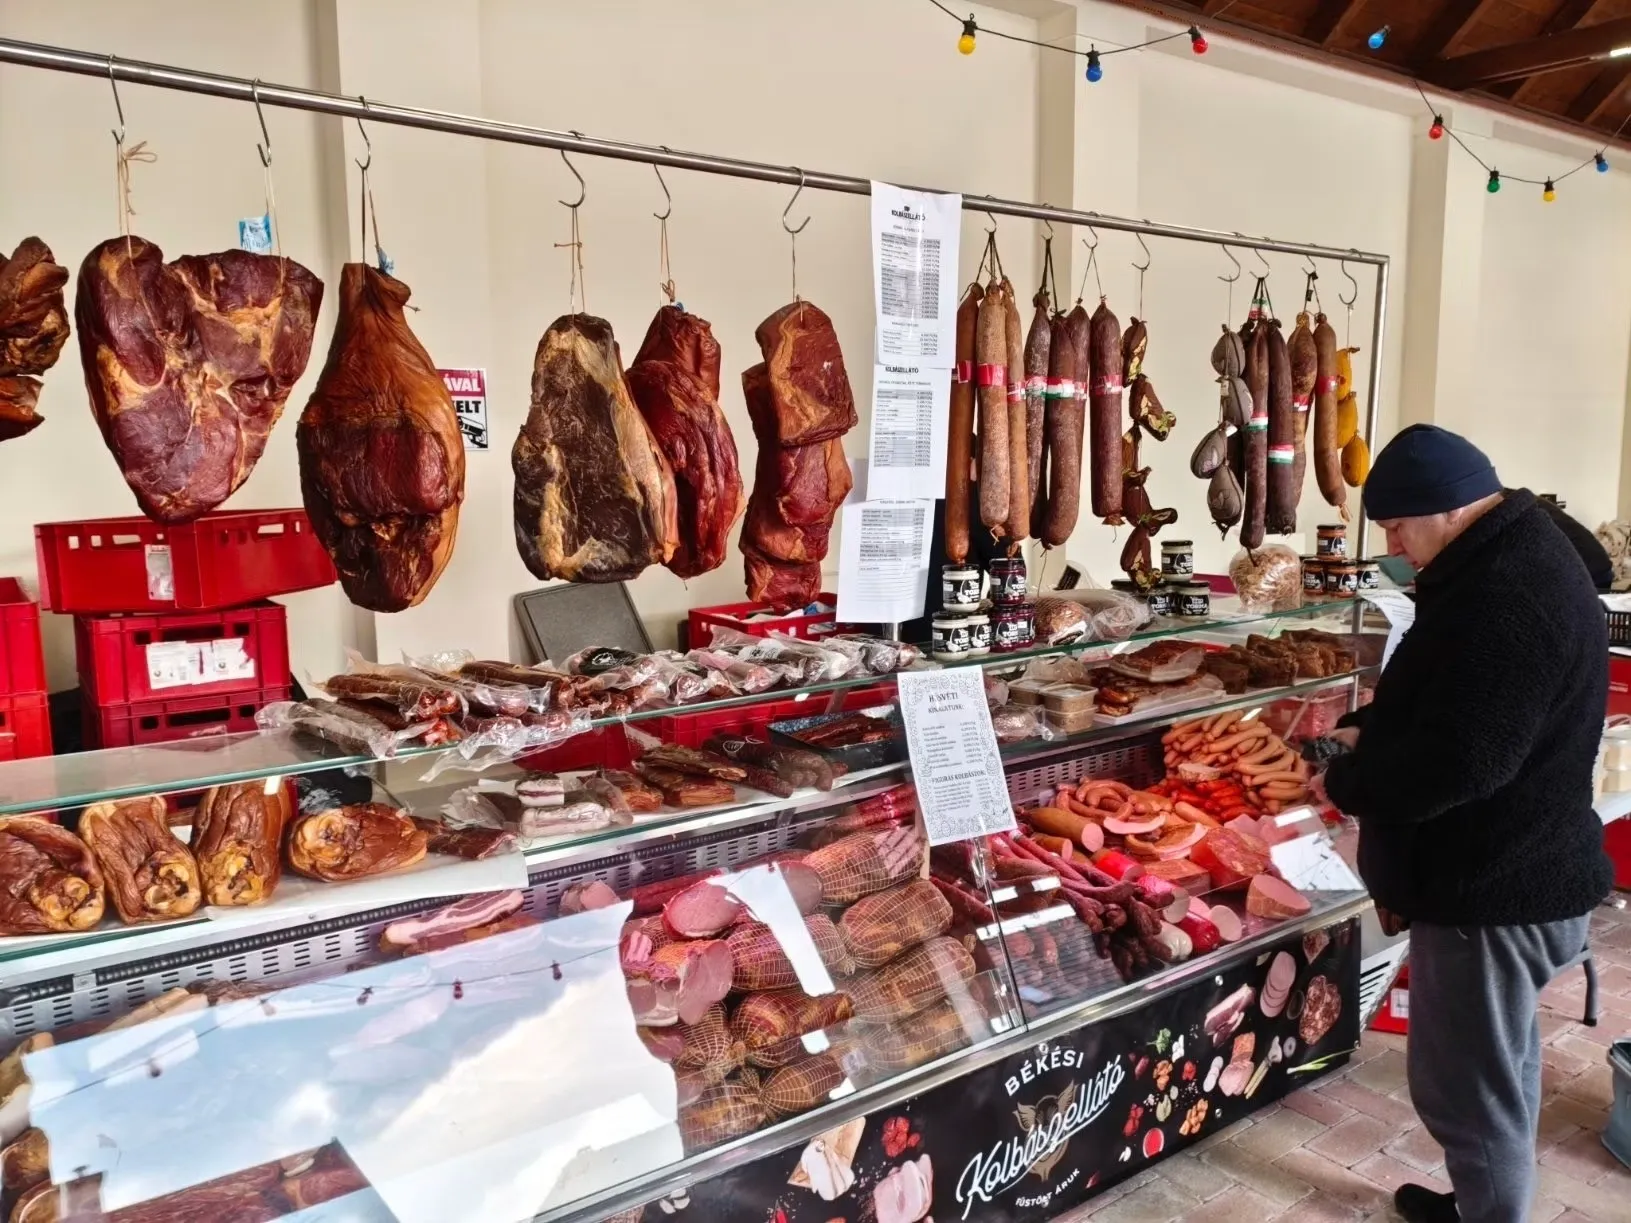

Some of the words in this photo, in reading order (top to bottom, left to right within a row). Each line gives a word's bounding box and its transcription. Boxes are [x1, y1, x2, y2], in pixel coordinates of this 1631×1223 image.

[452, 400, 481, 413] ELT
[928, 692, 959, 703] HSVÉTI
[1004, 1046, 1085, 1097] BÉKÉSI
[956, 1054, 1126, 1220] Kolbászellátó
[1055, 1169, 1081, 1195] ÁRUK
